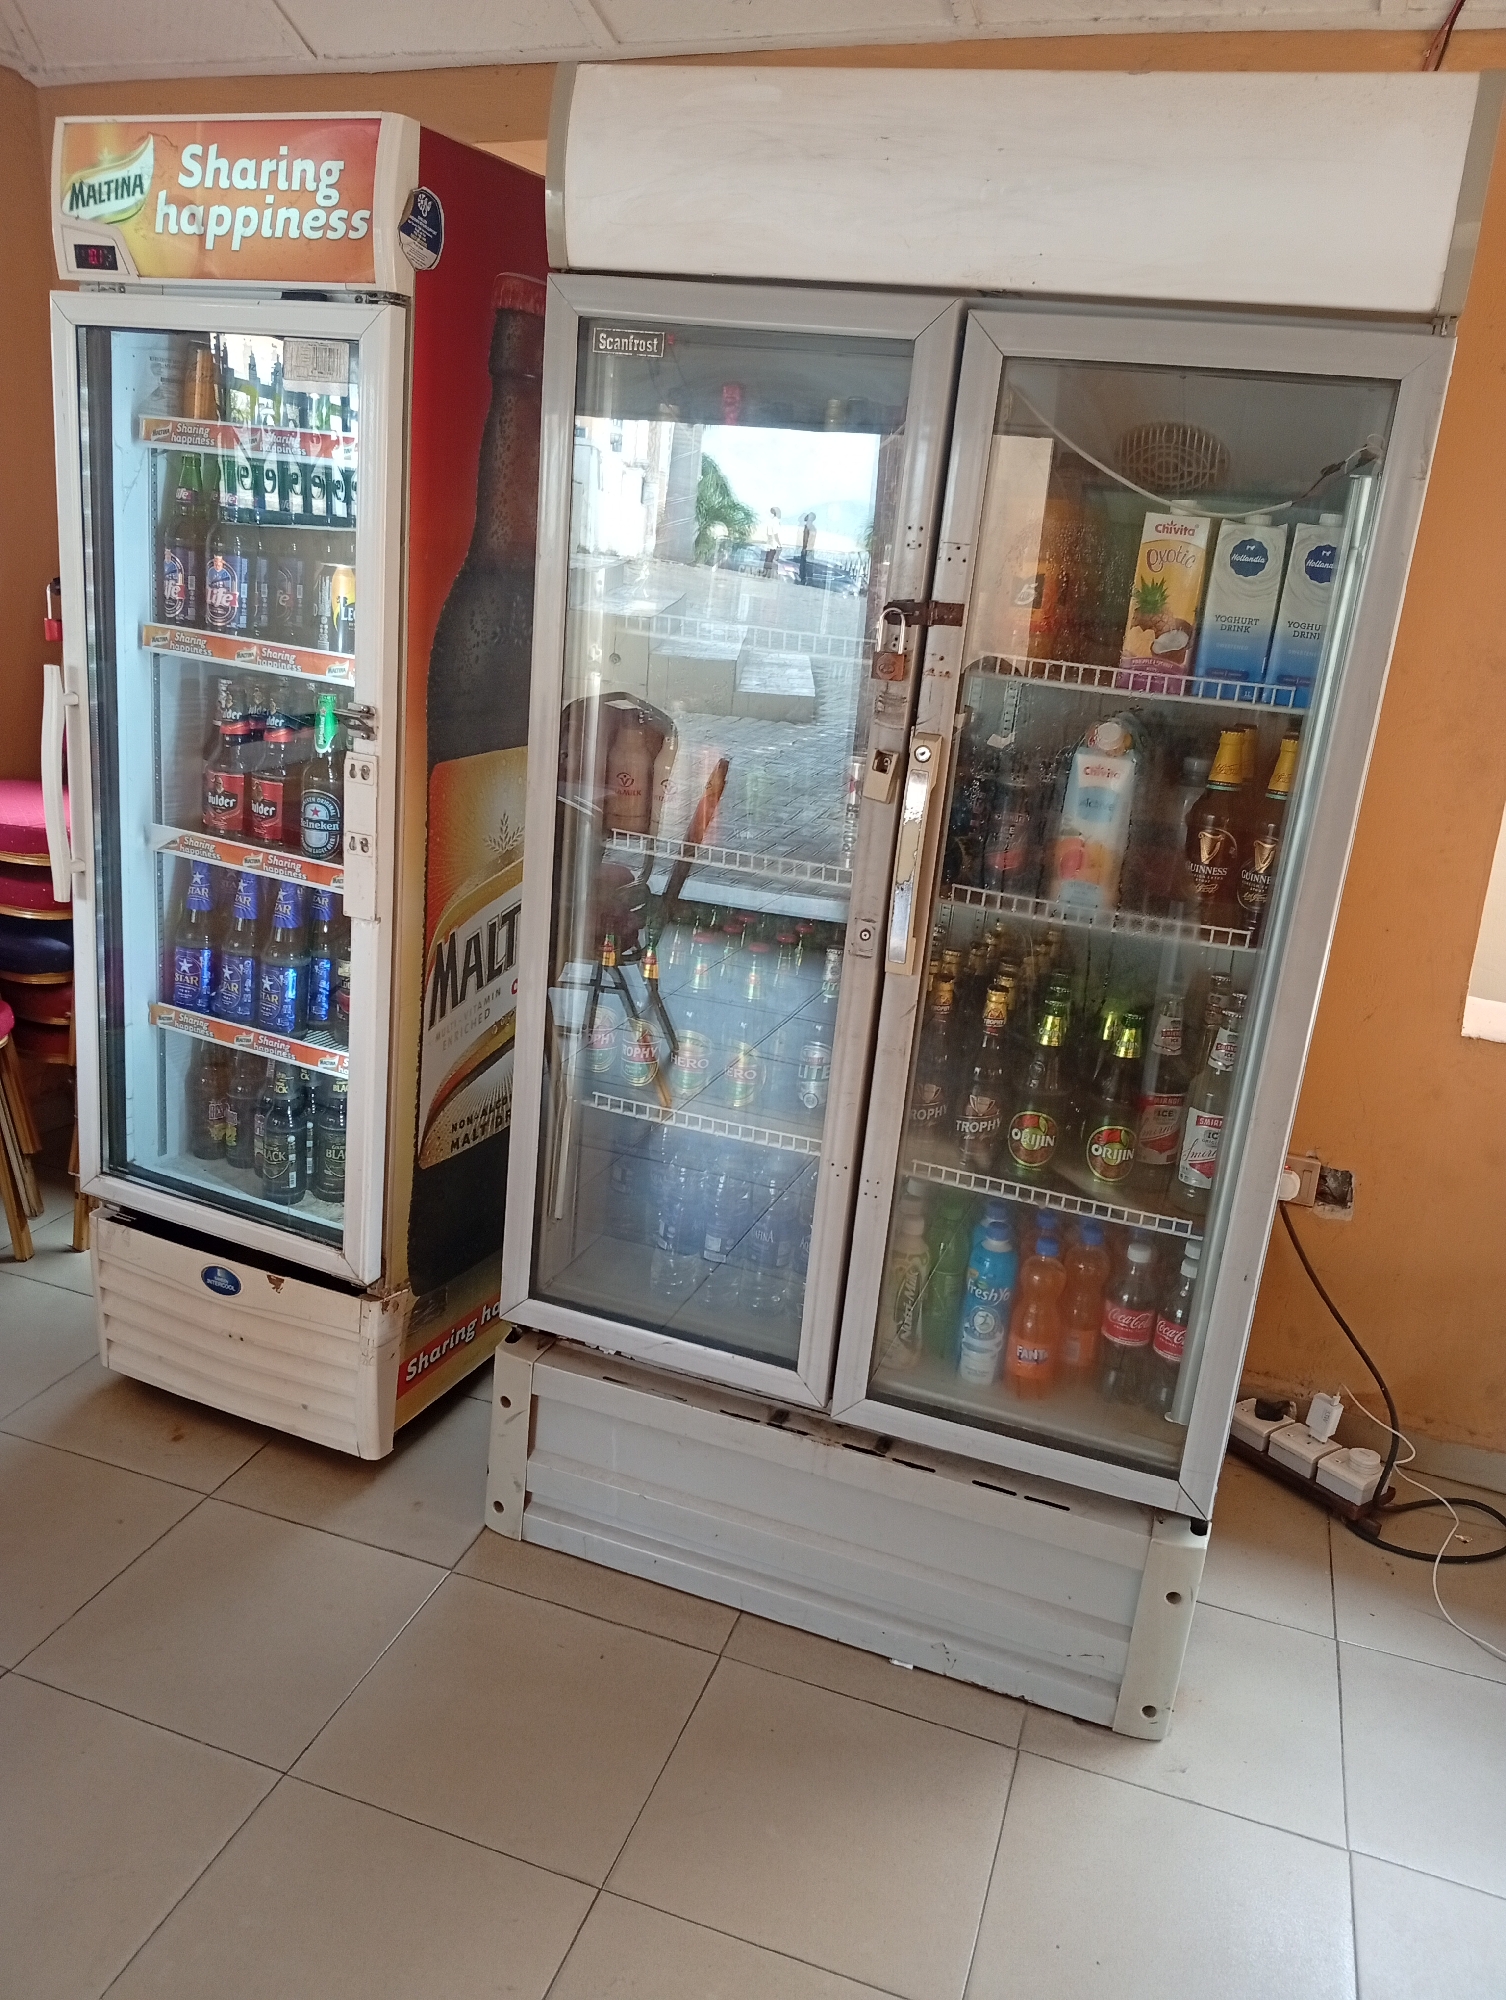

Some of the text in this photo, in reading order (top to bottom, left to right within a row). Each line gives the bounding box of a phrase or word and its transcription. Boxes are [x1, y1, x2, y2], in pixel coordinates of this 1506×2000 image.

[178, 143, 345, 207] Sharing
[69, 173, 144, 211] MALTINA
[154, 190, 371, 251] happiness
[599, 332, 659, 353] Scanfrost
[176, 422, 210, 438] Sharing
[171, 433, 215, 446] happiness
[1155, 520, 1196, 537] Chivita
[1231, 553, 1266, 564] Hollandia
[1215, 614, 1260, 626] YOGHURT
[1220, 624, 1250, 634] DRINK
[169, 642, 212, 656] happiness
[175, 632, 207, 649] Sharing
[262, 647, 296, 664] Sharing
[257, 657, 302, 673] happiness
[179, 845, 222, 860] happiness
[184, 836, 216, 852] Sharing
[263, 863, 307, 880] happiness
[267, 855, 302, 873] Sharing
[235, 893, 251, 905] TAR
[313, 894, 329, 906] TAR
[174, 974, 199, 986] STAR
[221, 981, 239, 994] TAR
[178, 1013, 209, 1030] Sharing
[435, 987, 501, 1042] MULTI-VITAMIN
[443, 1008, 491, 1051] ENRICHED
[253, 1044, 296, 1061] happiness
[258, 1035, 291, 1053] Sharing
[671, 1052, 709, 1069] HERO
[726, 1066, 757, 1080] ERO
[956, 1117, 1000, 1133] TROPHY
[451, 1122, 487, 1153] MALT
[1011, 1128, 1056, 1150] ORIJIN
[264, 1151, 287, 1161] LACK
[1091, 1143, 1134, 1163] ORIJIN
[406, 1318, 478, 1381] Sharing
